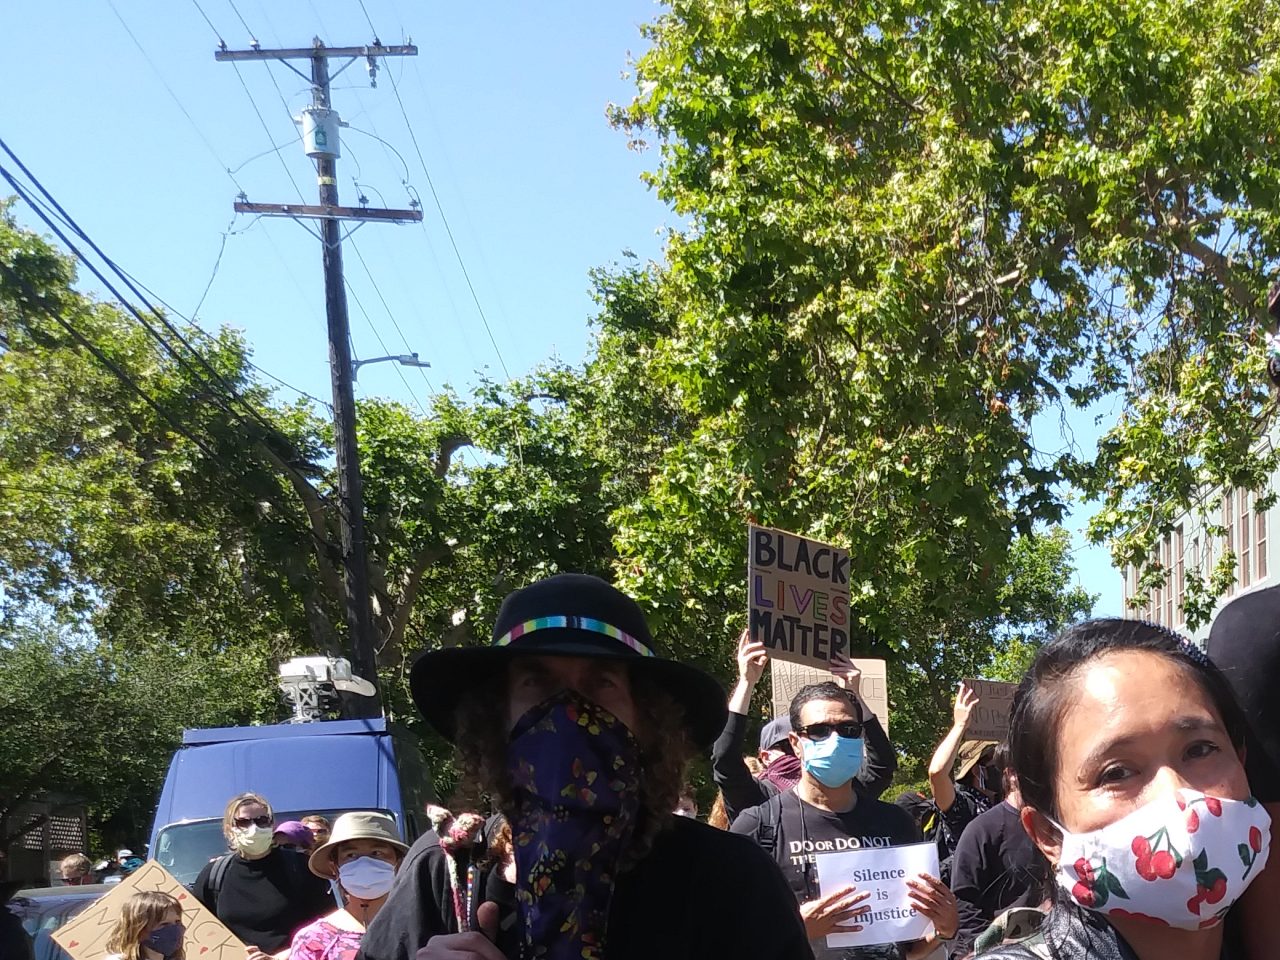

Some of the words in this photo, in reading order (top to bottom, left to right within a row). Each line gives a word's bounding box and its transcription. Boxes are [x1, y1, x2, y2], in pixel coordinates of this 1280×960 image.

[755, 531, 849, 585] BLACK
[755, 575, 849, 626] LIVES
[750, 608, 848, 662] MATTER
[789, 839, 814, 854] DO
[815, 840, 835, 851] OR
[834, 836, 860, 850] DO
[862, 835, 892, 848] NOT
[853, 868, 906, 882] Silence
[876, 888, 889, 901] is
